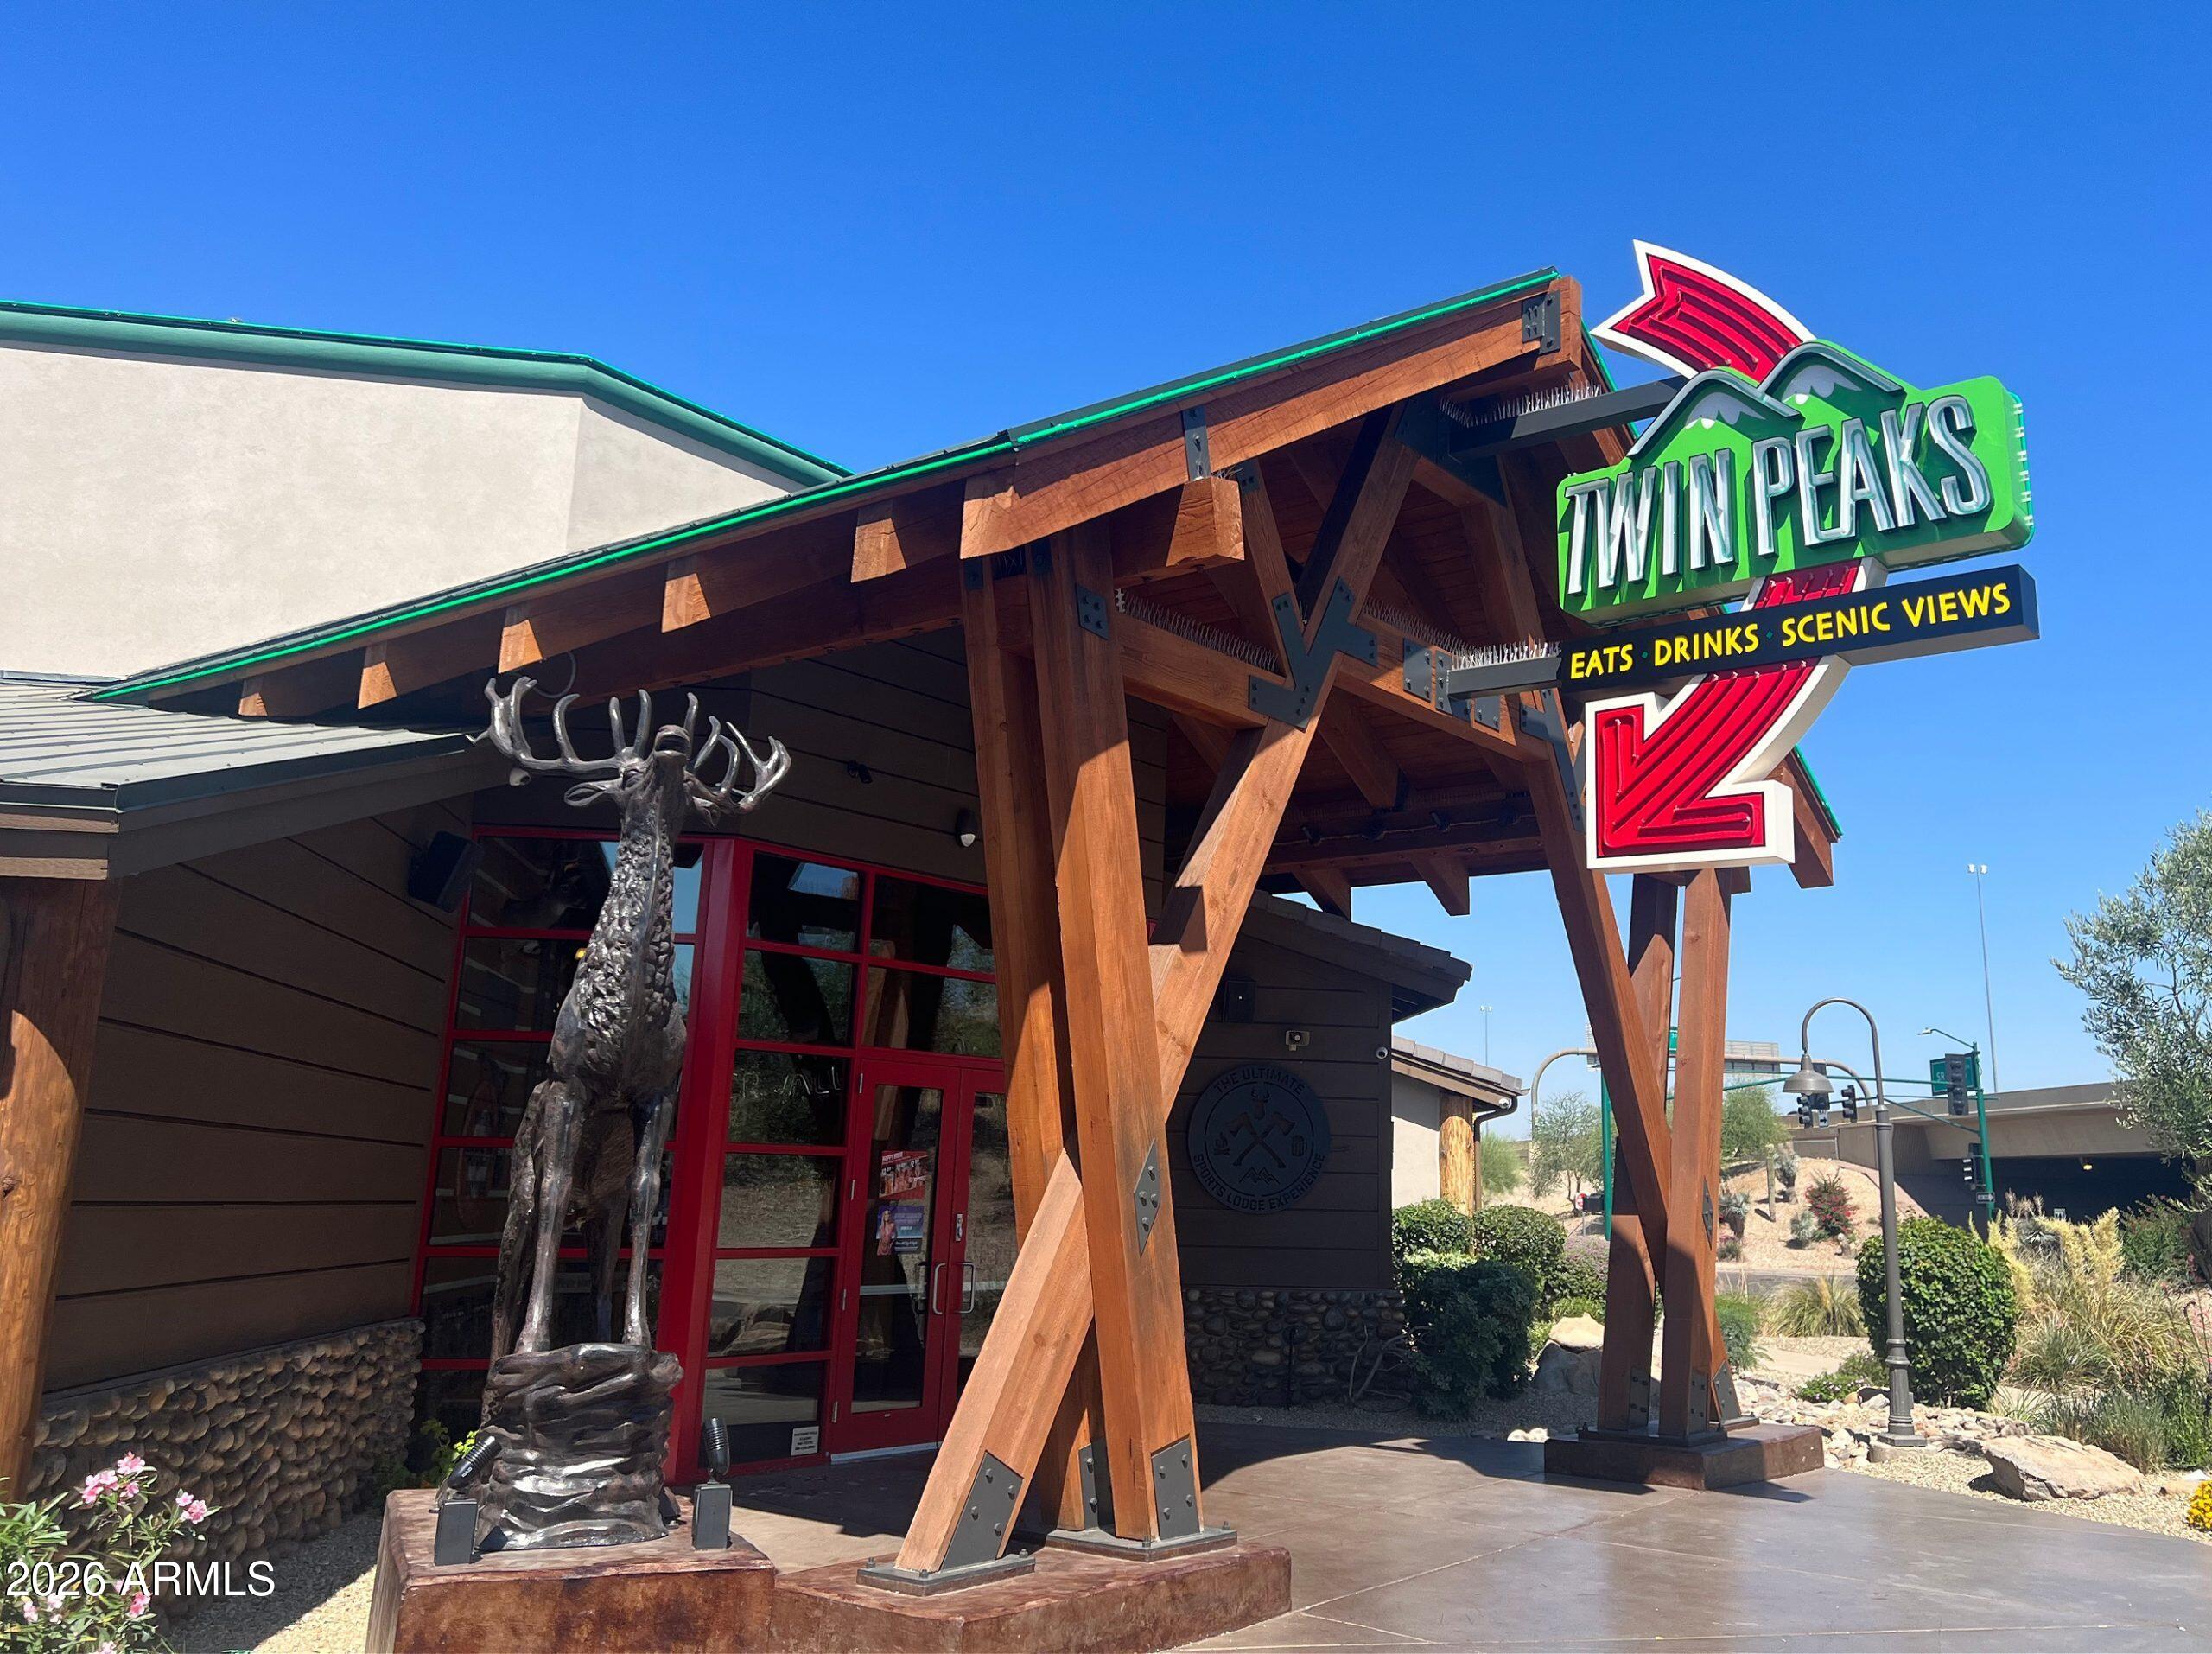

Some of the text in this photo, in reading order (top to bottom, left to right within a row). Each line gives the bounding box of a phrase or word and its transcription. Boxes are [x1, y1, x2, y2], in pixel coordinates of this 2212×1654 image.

[1565, 395, 1993, 595] TWIN PEAKS
[1570, 582, 2011, 679] EATS DRINKS SCENIC VIEWS
[1214, 1068, 1306, 1095] THE ULTIMATE
[1194, 1154, 1325, 1211] SPORTS LODGE EXPERIENCE
